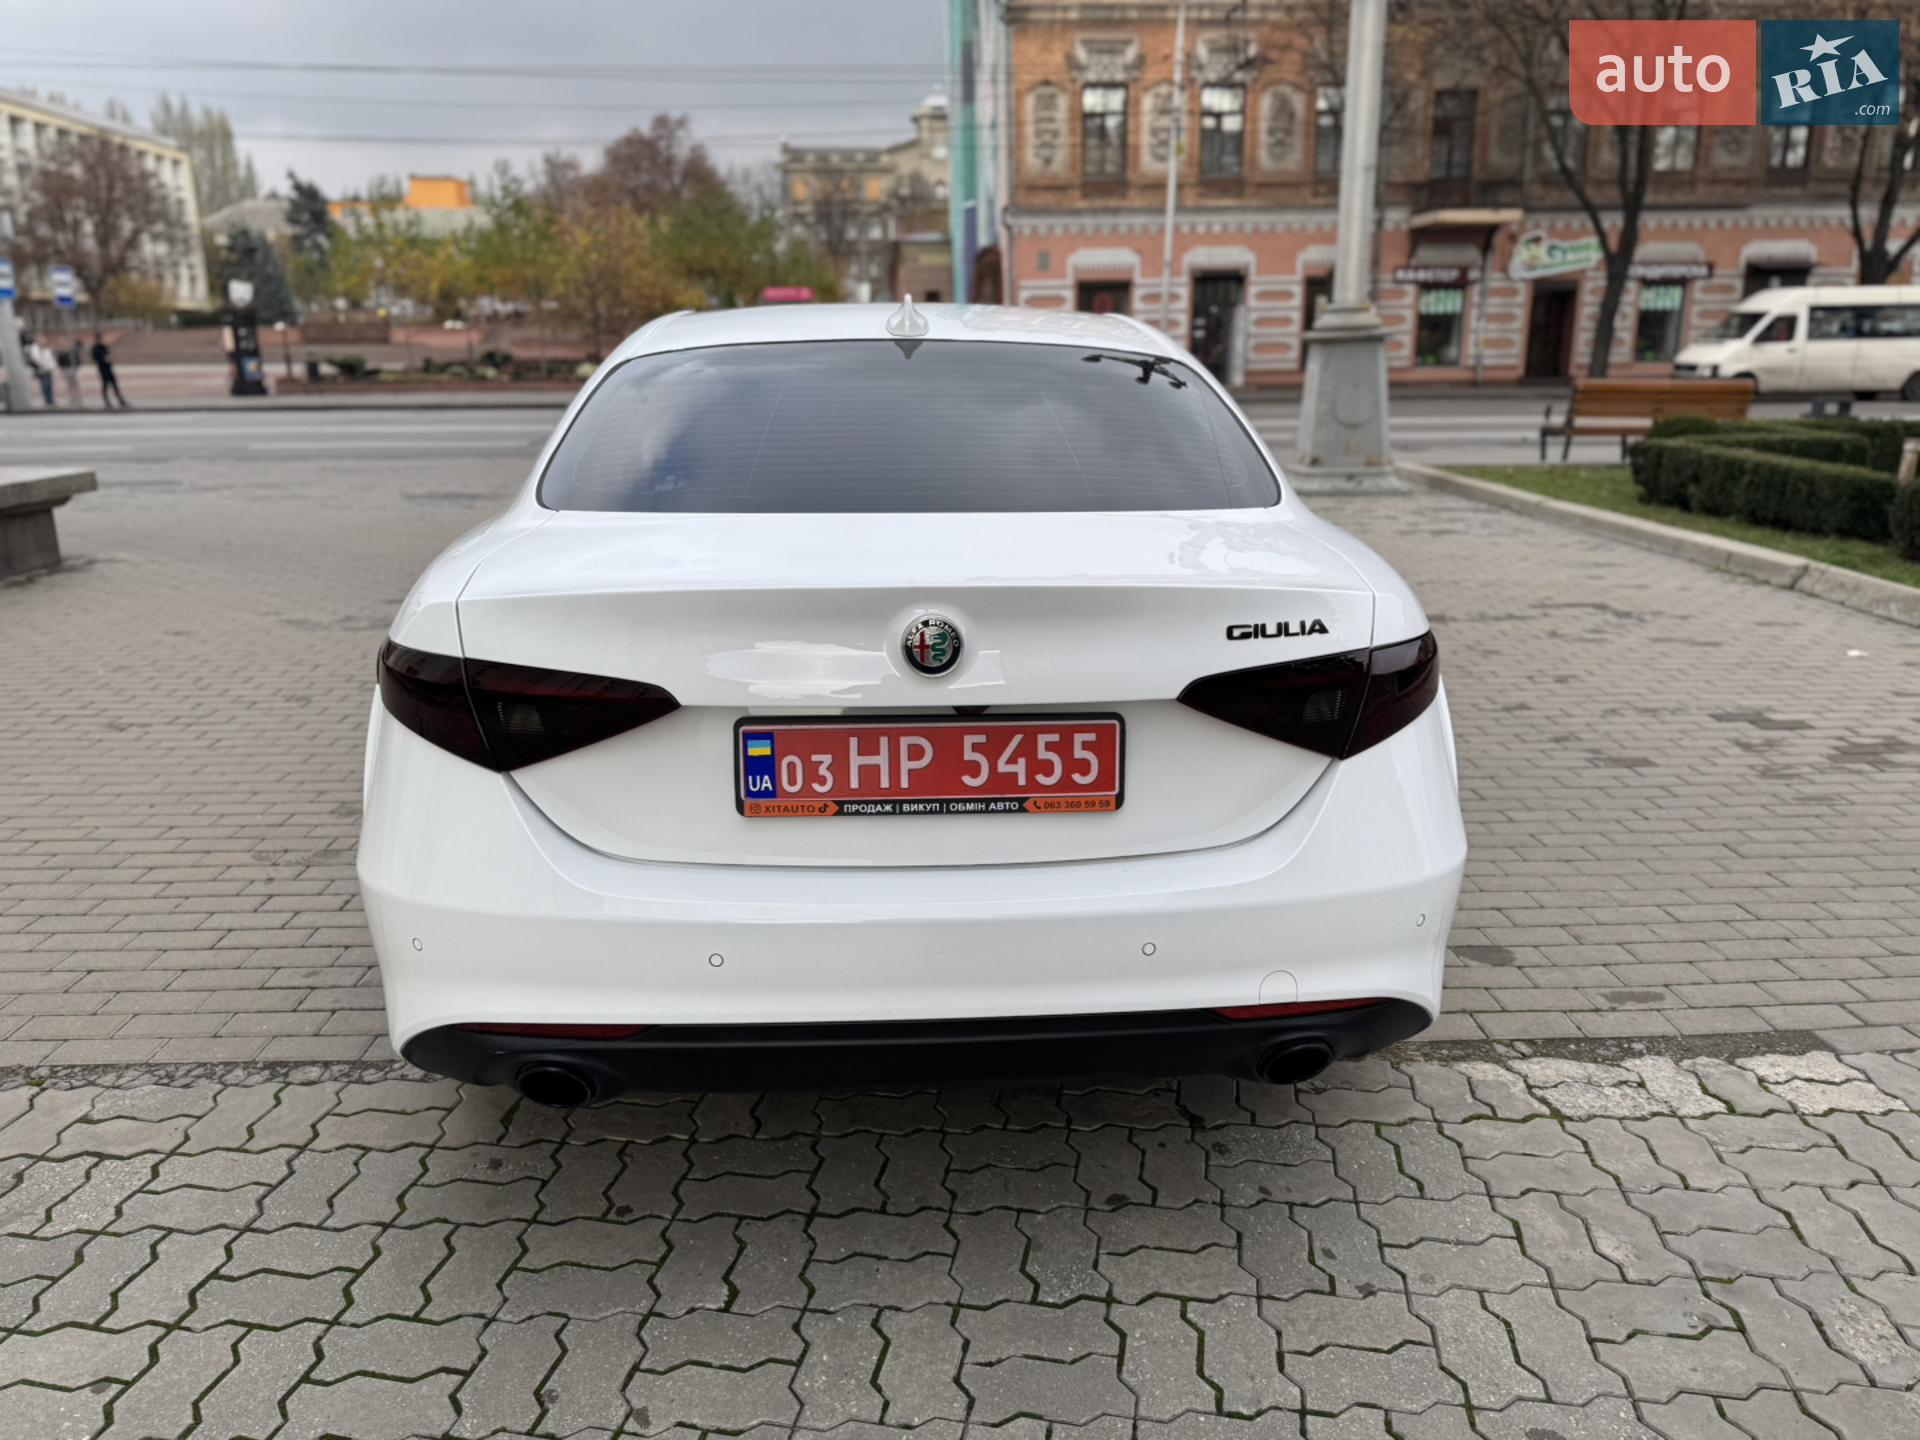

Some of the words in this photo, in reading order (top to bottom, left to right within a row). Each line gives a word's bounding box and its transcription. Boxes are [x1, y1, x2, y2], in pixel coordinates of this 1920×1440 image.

[906, 623, 924, 648] ALFA
[928, 619, 960, 648] ROMEO
[1226, 618, 1330, 641] GIULIA
[780, 754, 835, 794] 03
[848, 735, 935, 790] HP
[960, 732, 1100, 788] 5455
[748, 775, 773, 792] UA
[764, 804, 816, 814] XITAUTO
[843, 803, 893, 814] ПРОДАЖ
[902, 803, 940, 812] ВИКУП
[949, 802, 986, 811] ОБМІН
[988, 801, 1019, 811] АВТО
[1043, 800, 1061, 810] 063
[1064, 800, 1082, 809] 360
[1084, 800, 1097, 809] 59
[1098, 799, 1111, 809] 59
